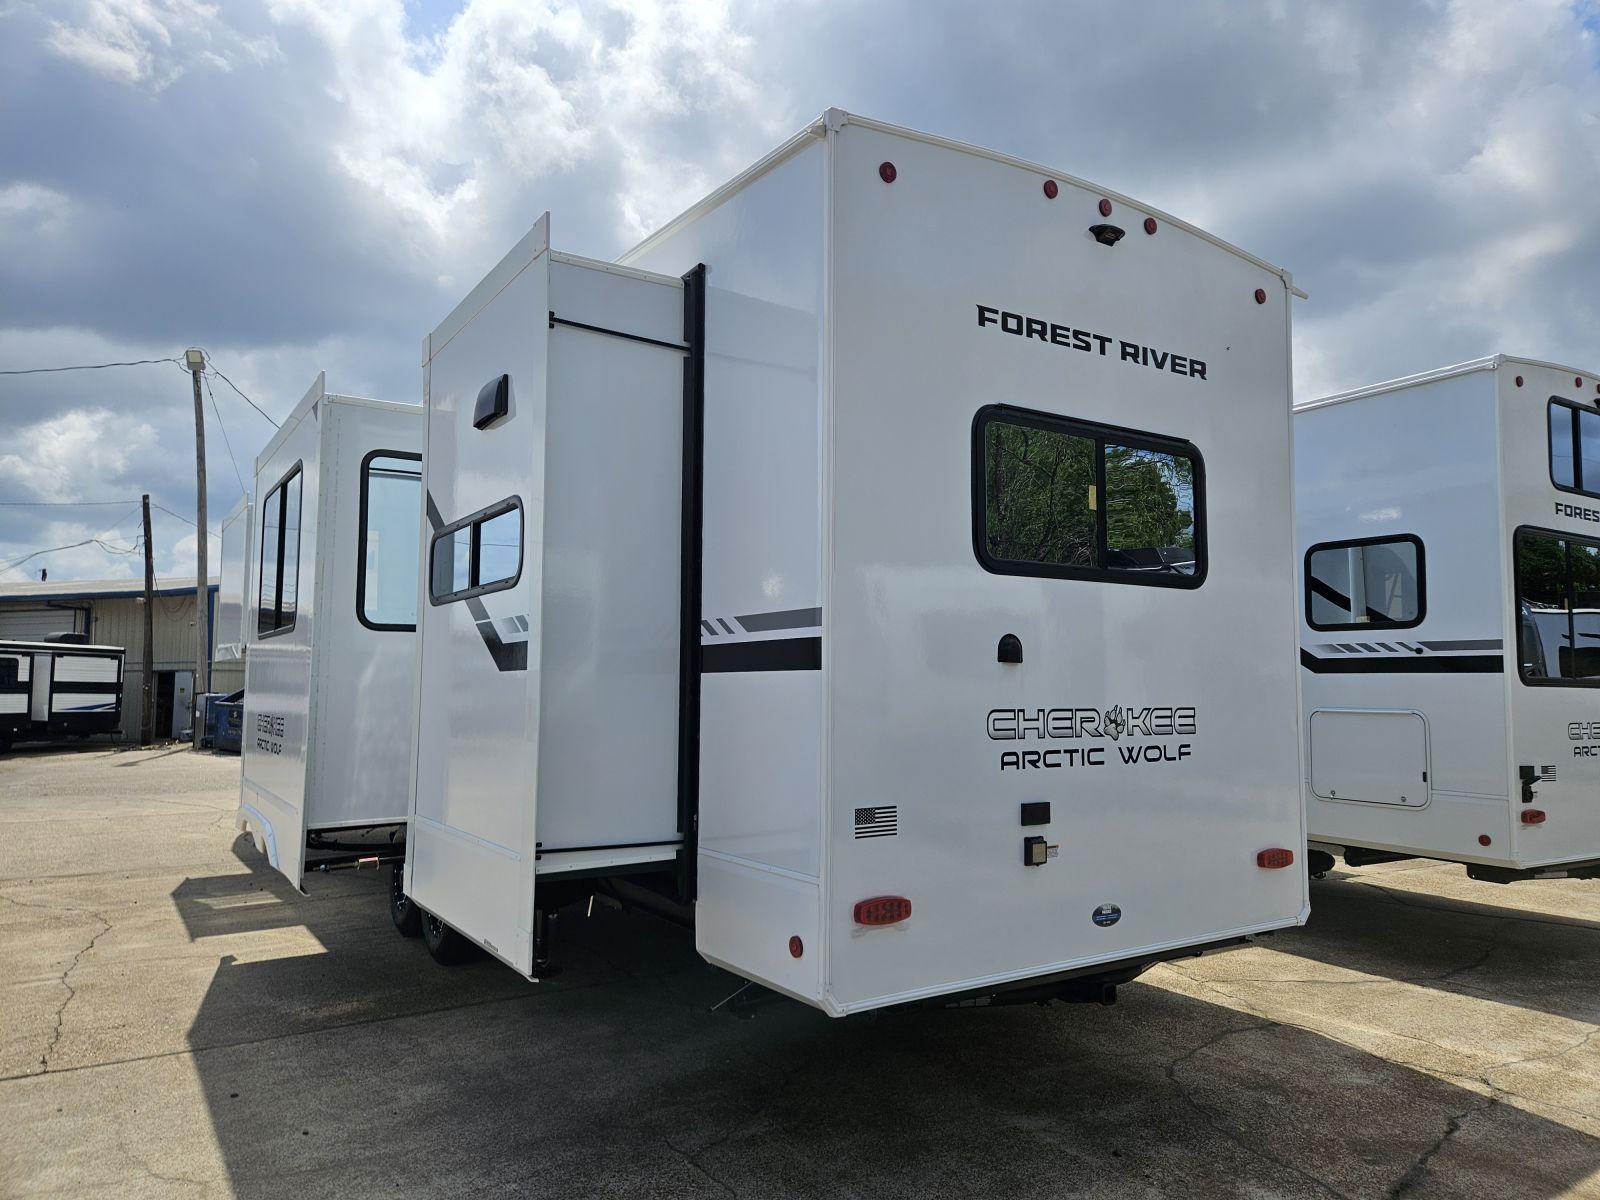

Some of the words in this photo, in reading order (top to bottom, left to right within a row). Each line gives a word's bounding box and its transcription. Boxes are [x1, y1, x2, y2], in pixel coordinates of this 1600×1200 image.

[975, 303, 1113, 356] FOREST
[1118, 339, 1208, 381] RIVER
[1000, 747, 1105, 771] ARCTIC
[1118, 743, 1192, 765] WOLF
